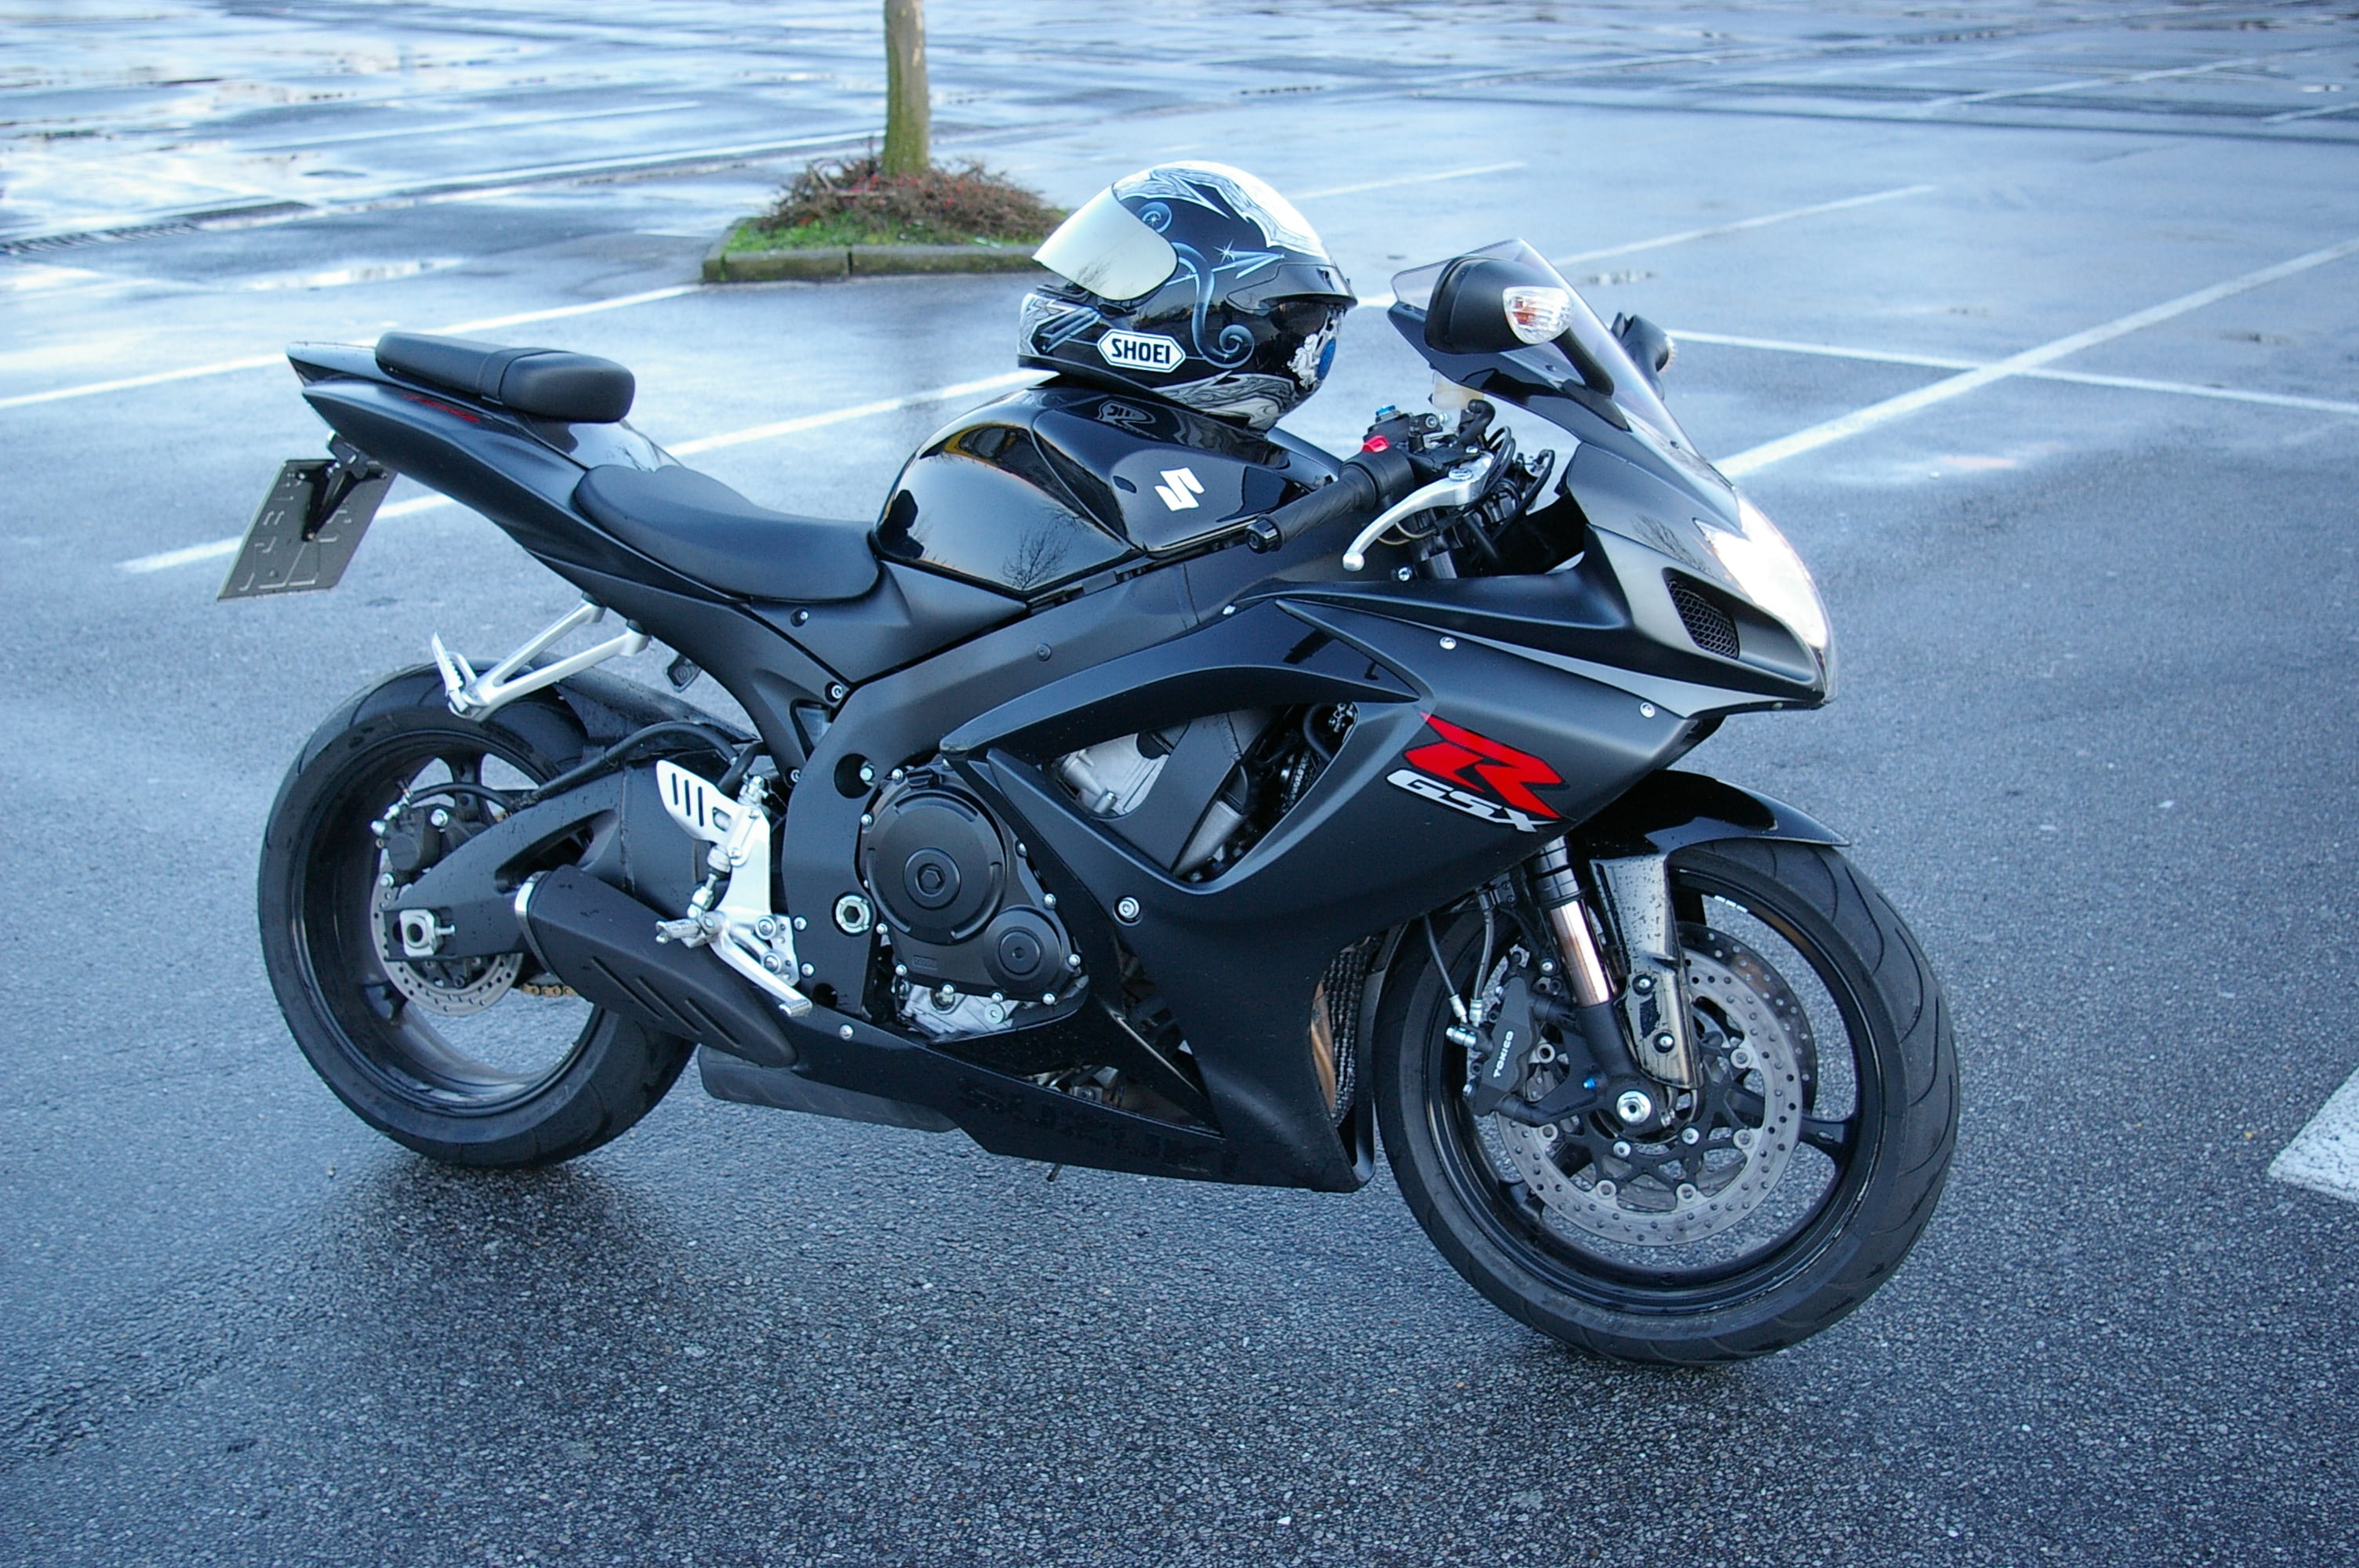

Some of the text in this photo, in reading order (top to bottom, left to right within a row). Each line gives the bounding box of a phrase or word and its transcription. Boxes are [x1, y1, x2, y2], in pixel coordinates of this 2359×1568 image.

[1111, 338, 1170, 364] SHOEI
[1386, 769, 1557, 833] GSX
[1492, 1030, 1514, 1078] TOKICO
